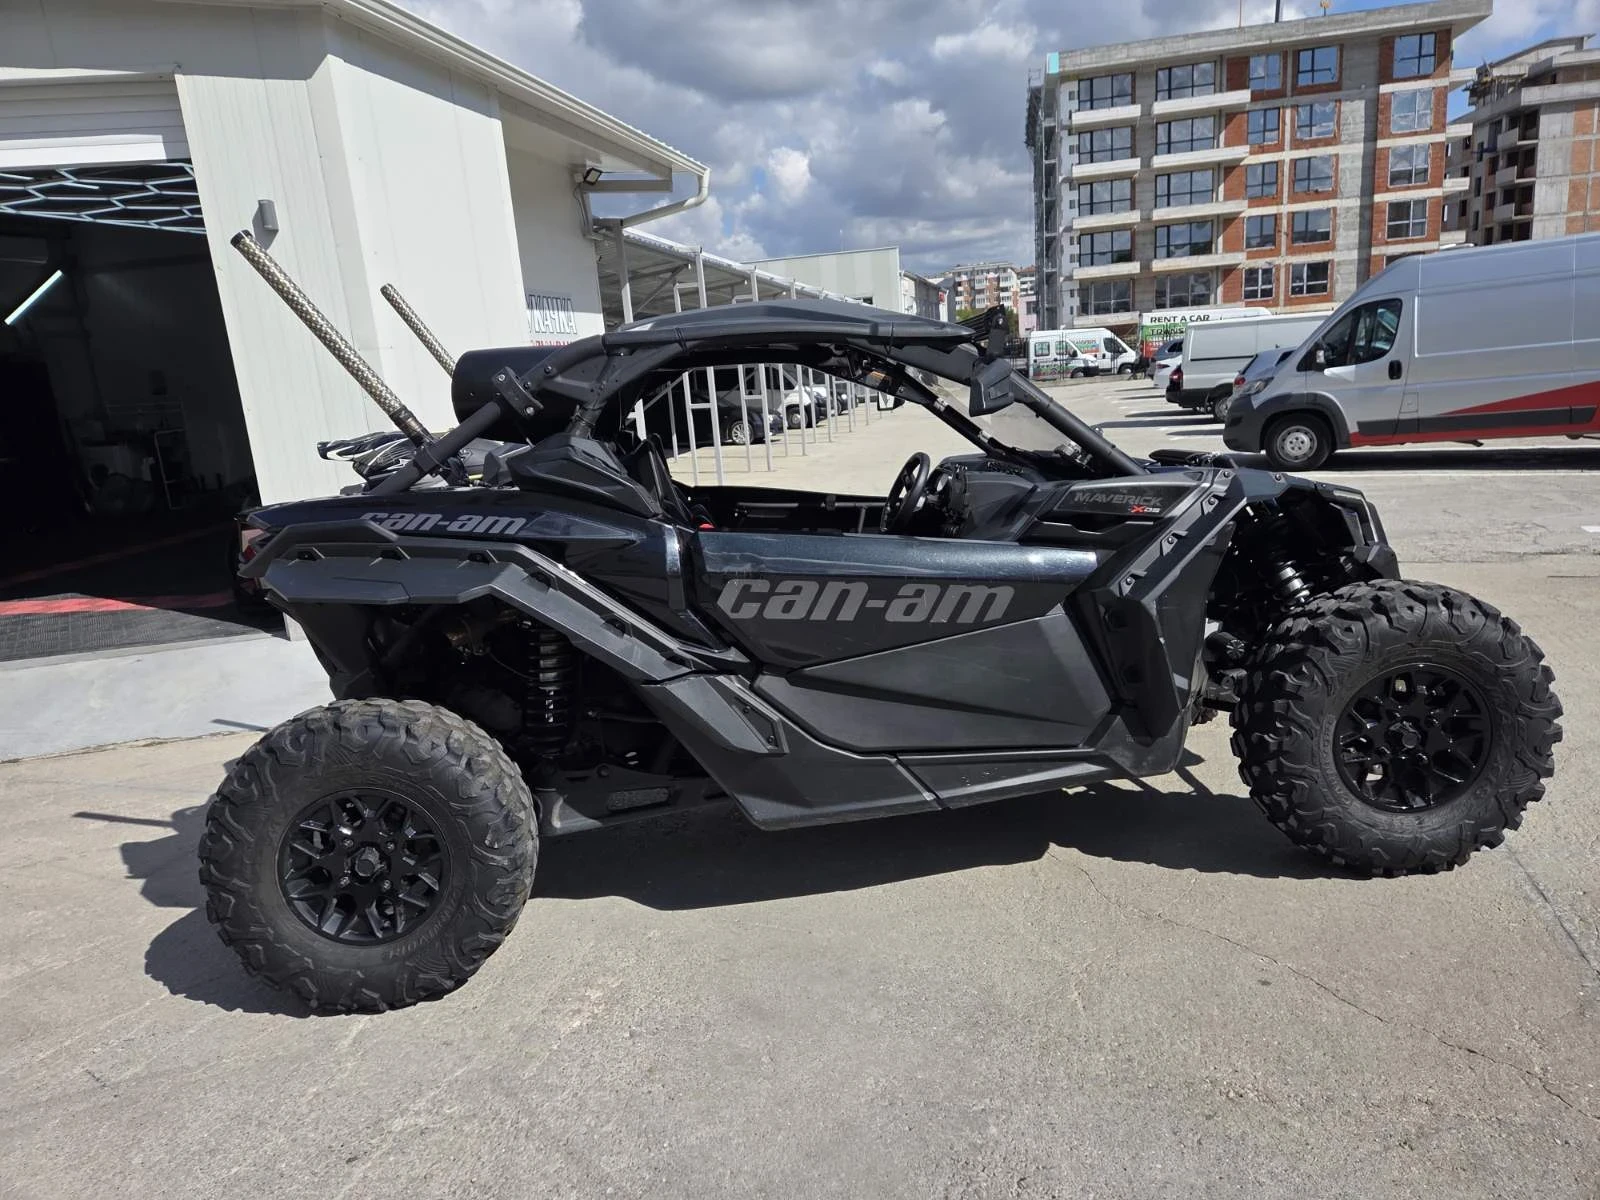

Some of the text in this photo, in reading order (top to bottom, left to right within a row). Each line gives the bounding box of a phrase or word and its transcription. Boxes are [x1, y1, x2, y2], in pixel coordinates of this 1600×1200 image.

[1150, 314, 1210, 323] RENT A CAR
[1150, 327, 1187, 336] TRANS
[1073, 492, 1163, 506] MAVERICK
[716, 578, 1016, 624] can-am
